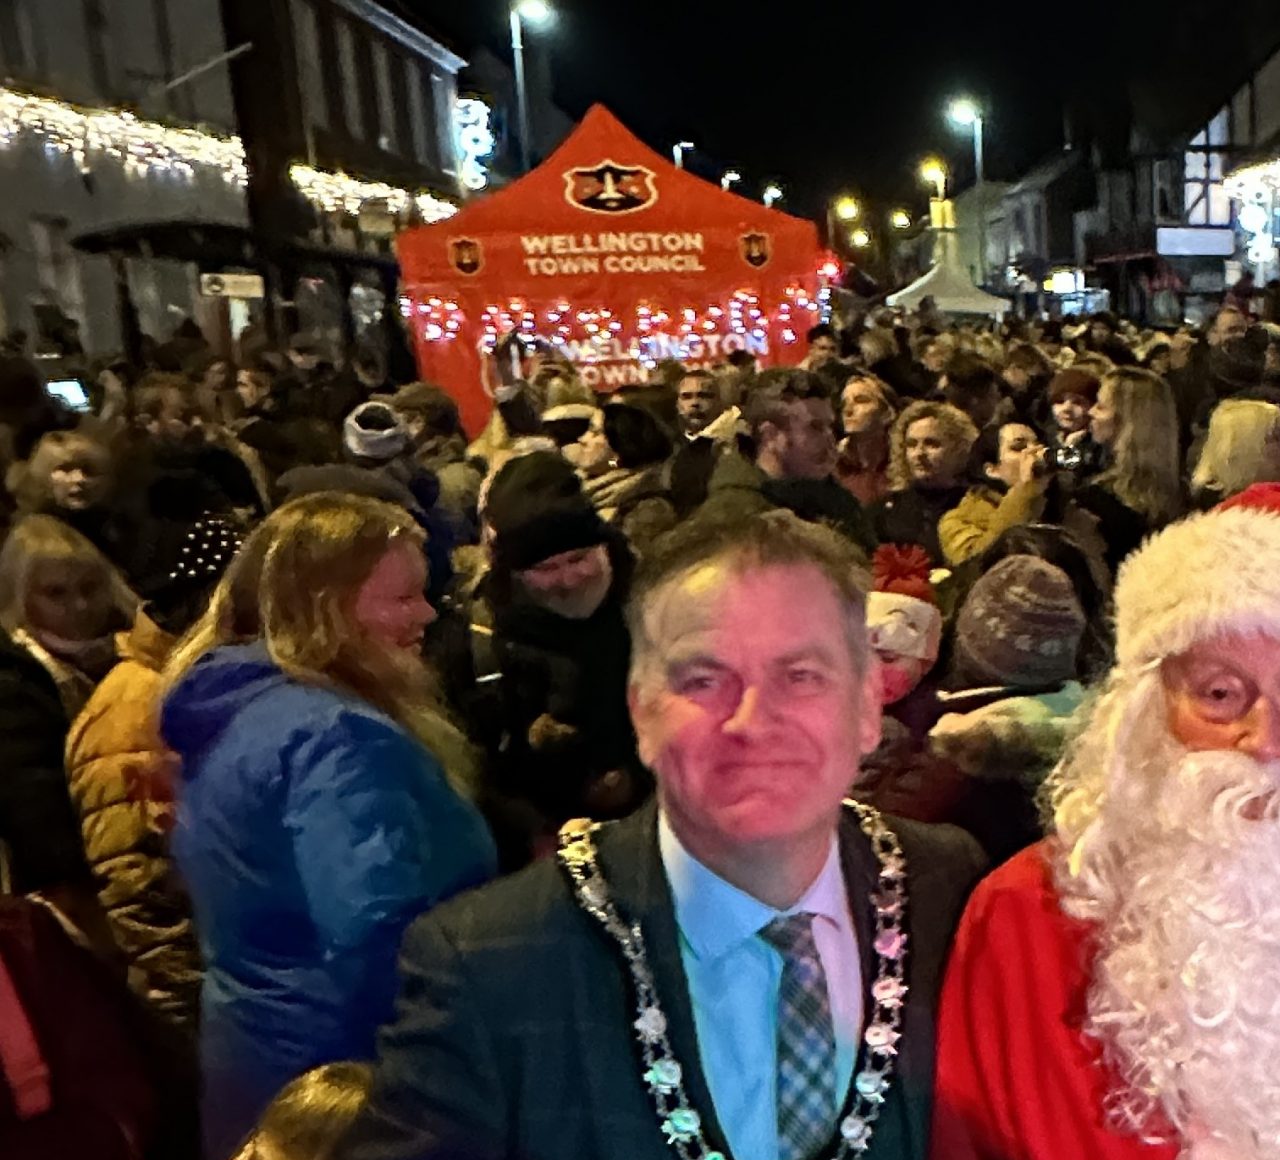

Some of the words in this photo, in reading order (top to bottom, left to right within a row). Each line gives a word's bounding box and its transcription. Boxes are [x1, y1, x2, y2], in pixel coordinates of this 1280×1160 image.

[520, 232, 704, 254] WELLINGTON
[524, 257, 600, 275] TOWN
[603, 254, 706, 273] COUNCIL
